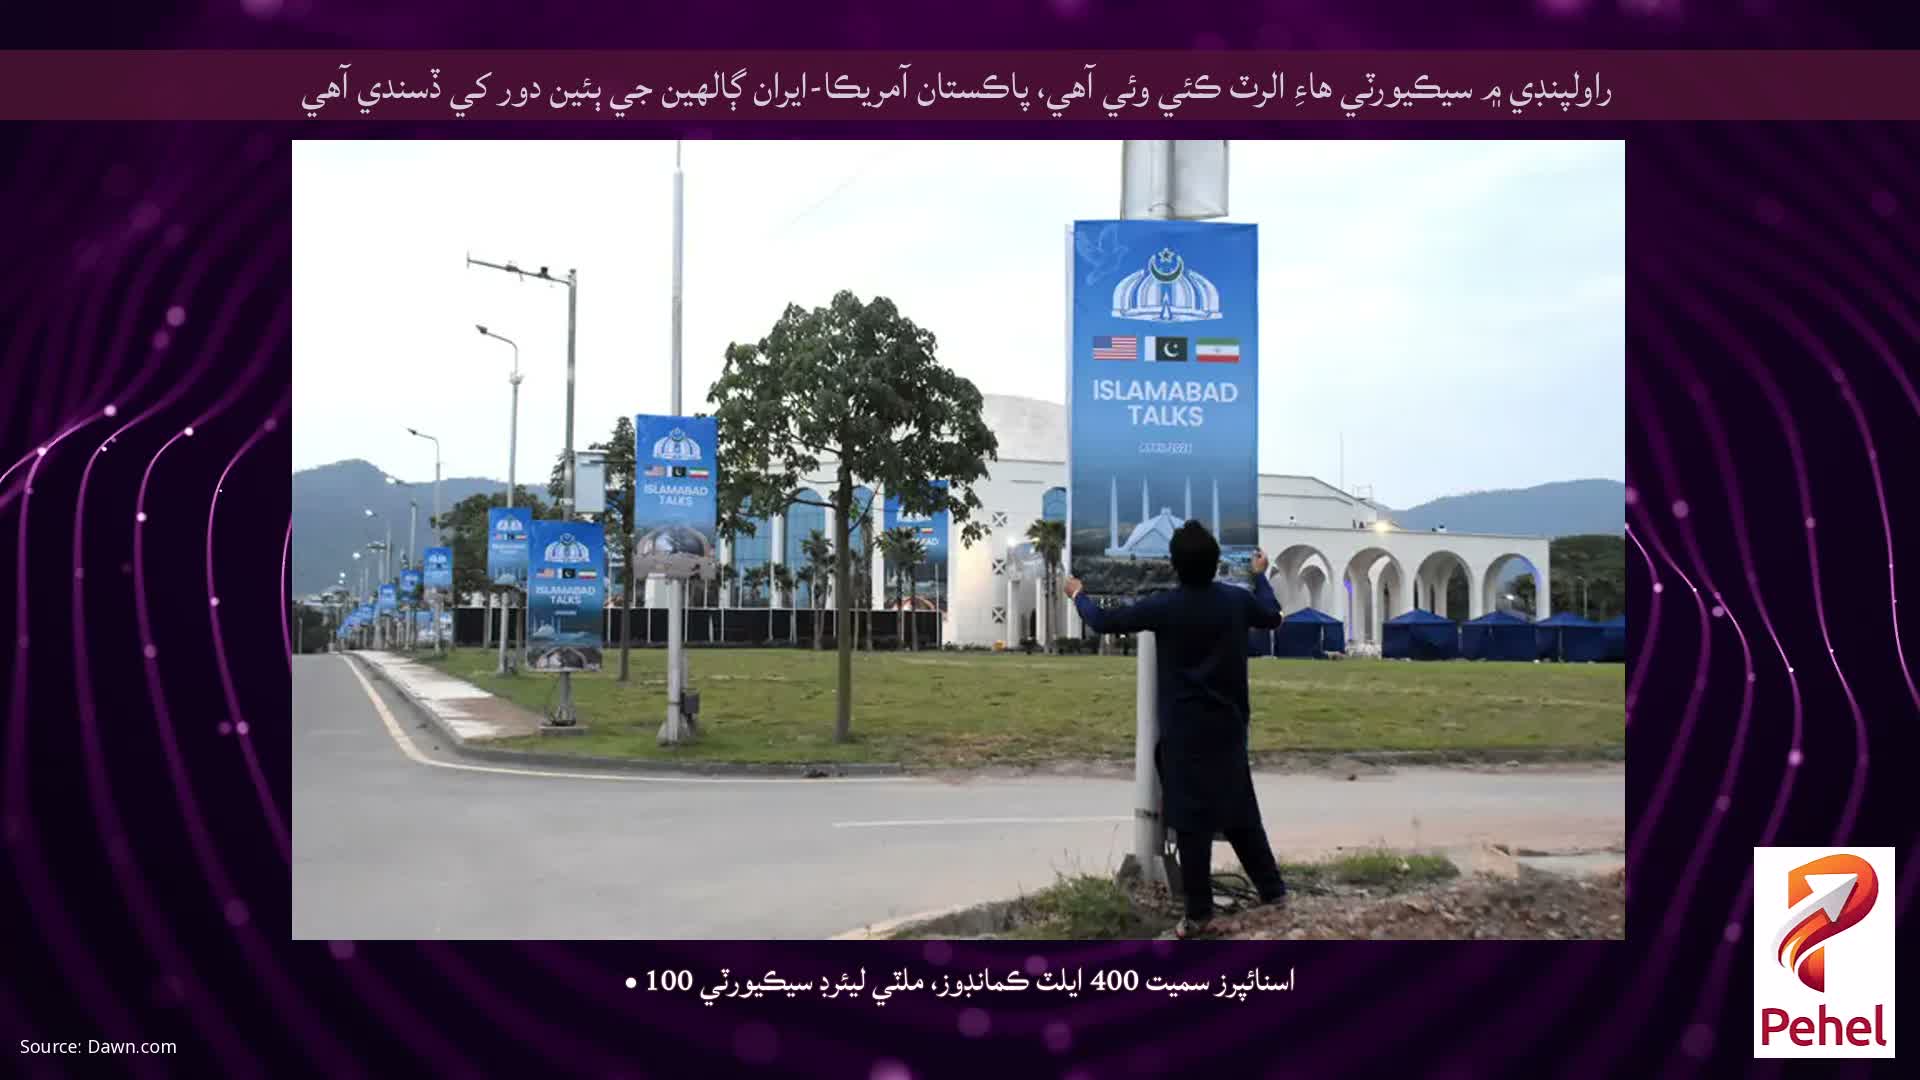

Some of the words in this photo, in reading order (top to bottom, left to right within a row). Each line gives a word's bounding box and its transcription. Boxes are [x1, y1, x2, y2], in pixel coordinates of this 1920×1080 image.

[1093, 378, 1239, 402] ISLAMABAD
[1127, 404, 1204, 427] TALKS
[643, 483, 709, 496] ISLAMABAD
[659, 495, 694, 507] TALKS
